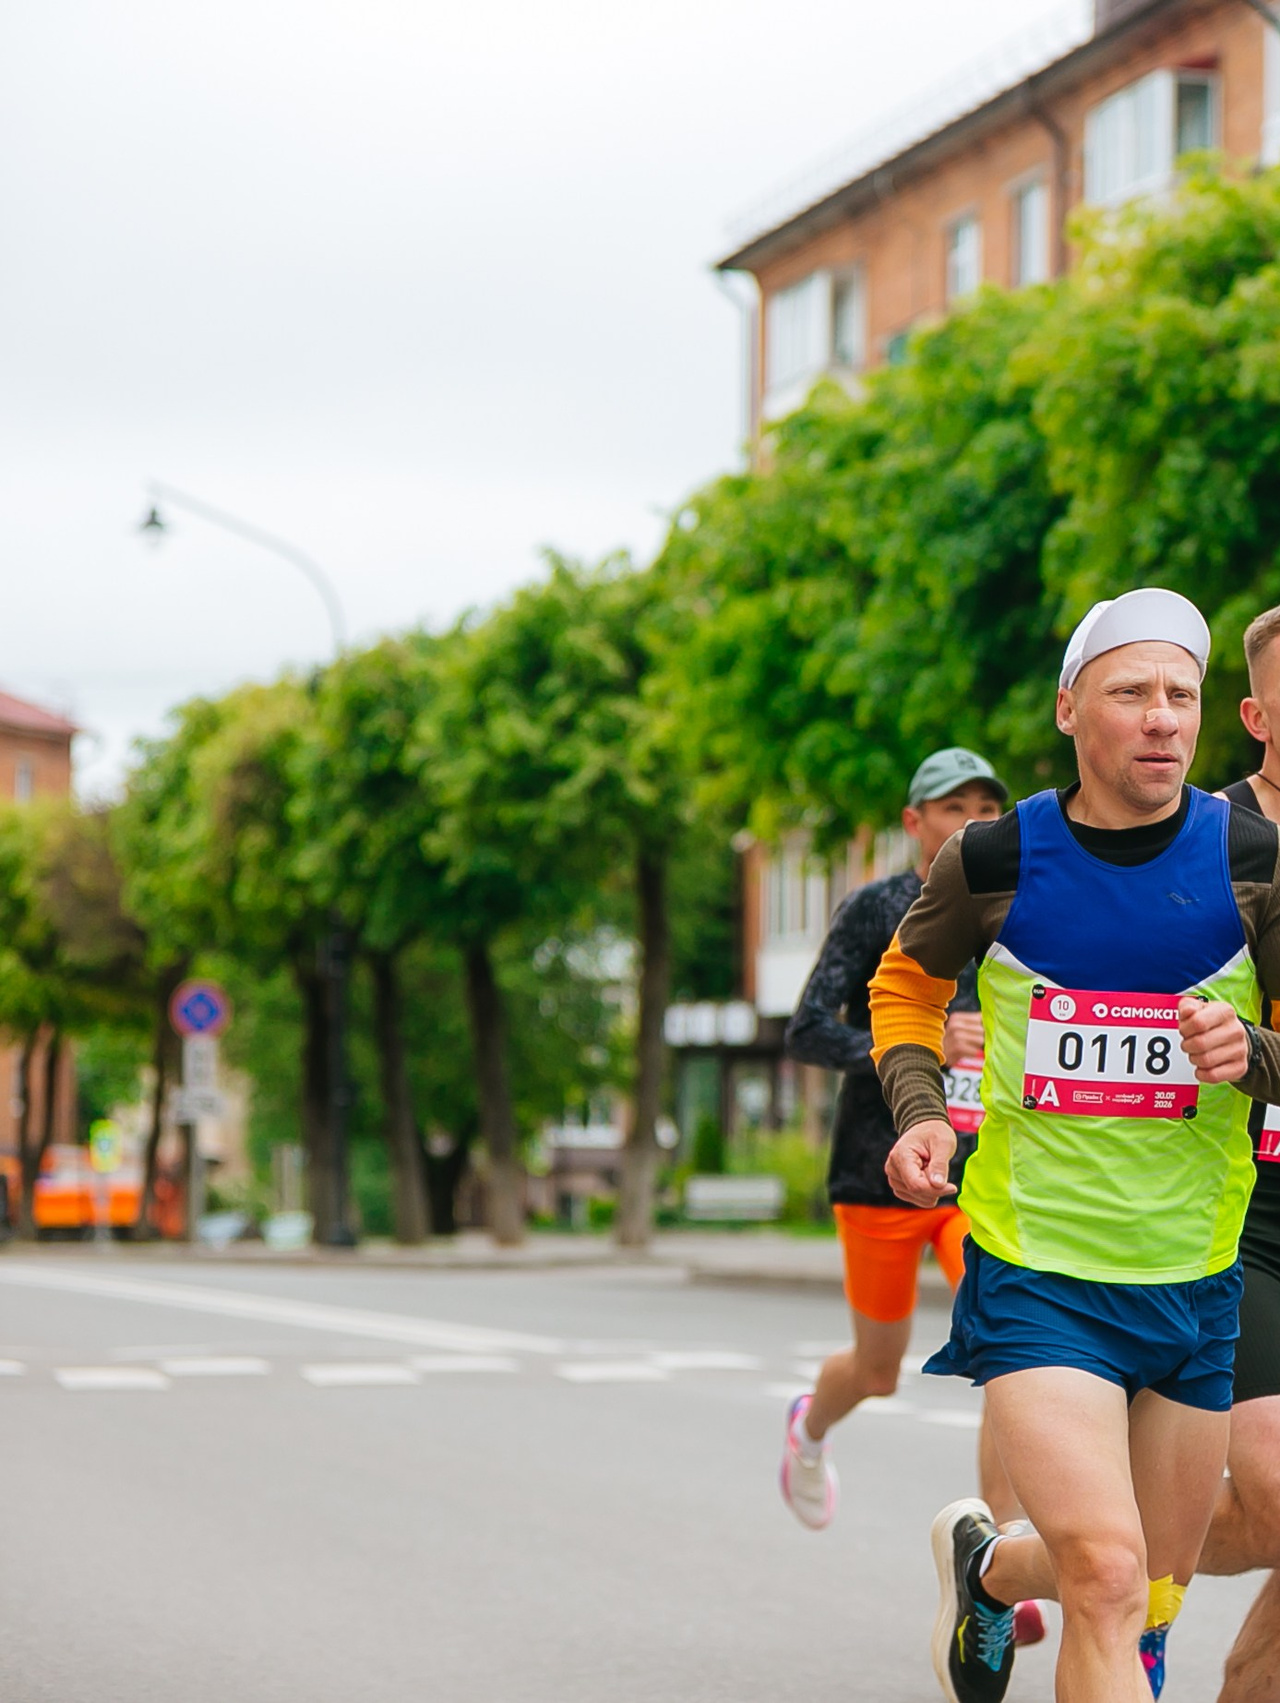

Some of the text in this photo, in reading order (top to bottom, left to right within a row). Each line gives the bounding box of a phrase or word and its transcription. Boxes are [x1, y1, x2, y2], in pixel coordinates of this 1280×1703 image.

[1057, 1000, 1069, 1011] 10
[1057, 1031, 1172, 1075] 0118
[1154, 1091, 1176, 1100] 30.05
[1153, 1100, 1173, 1108] 2026
